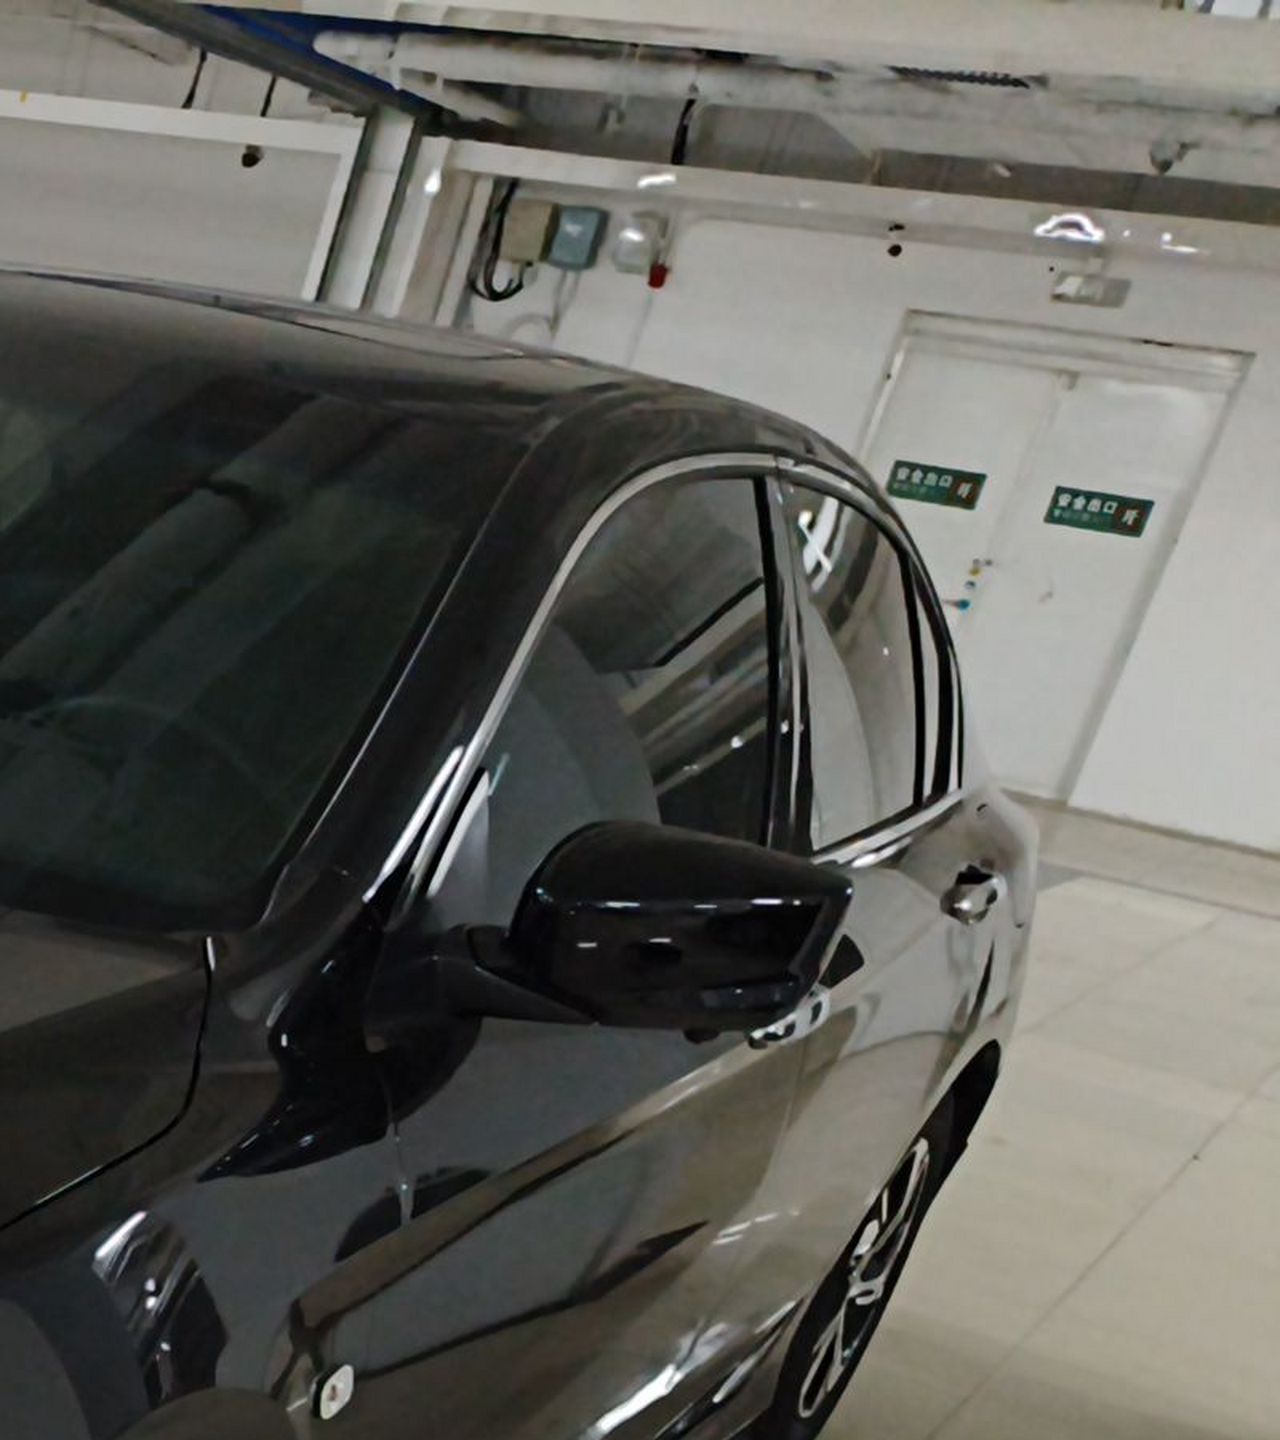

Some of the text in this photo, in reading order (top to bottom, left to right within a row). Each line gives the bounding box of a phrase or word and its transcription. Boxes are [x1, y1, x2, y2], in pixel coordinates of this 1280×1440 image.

[896, 467, 953, 487] 安全出口
[1057, 493, 1118, 514] 安全出口
